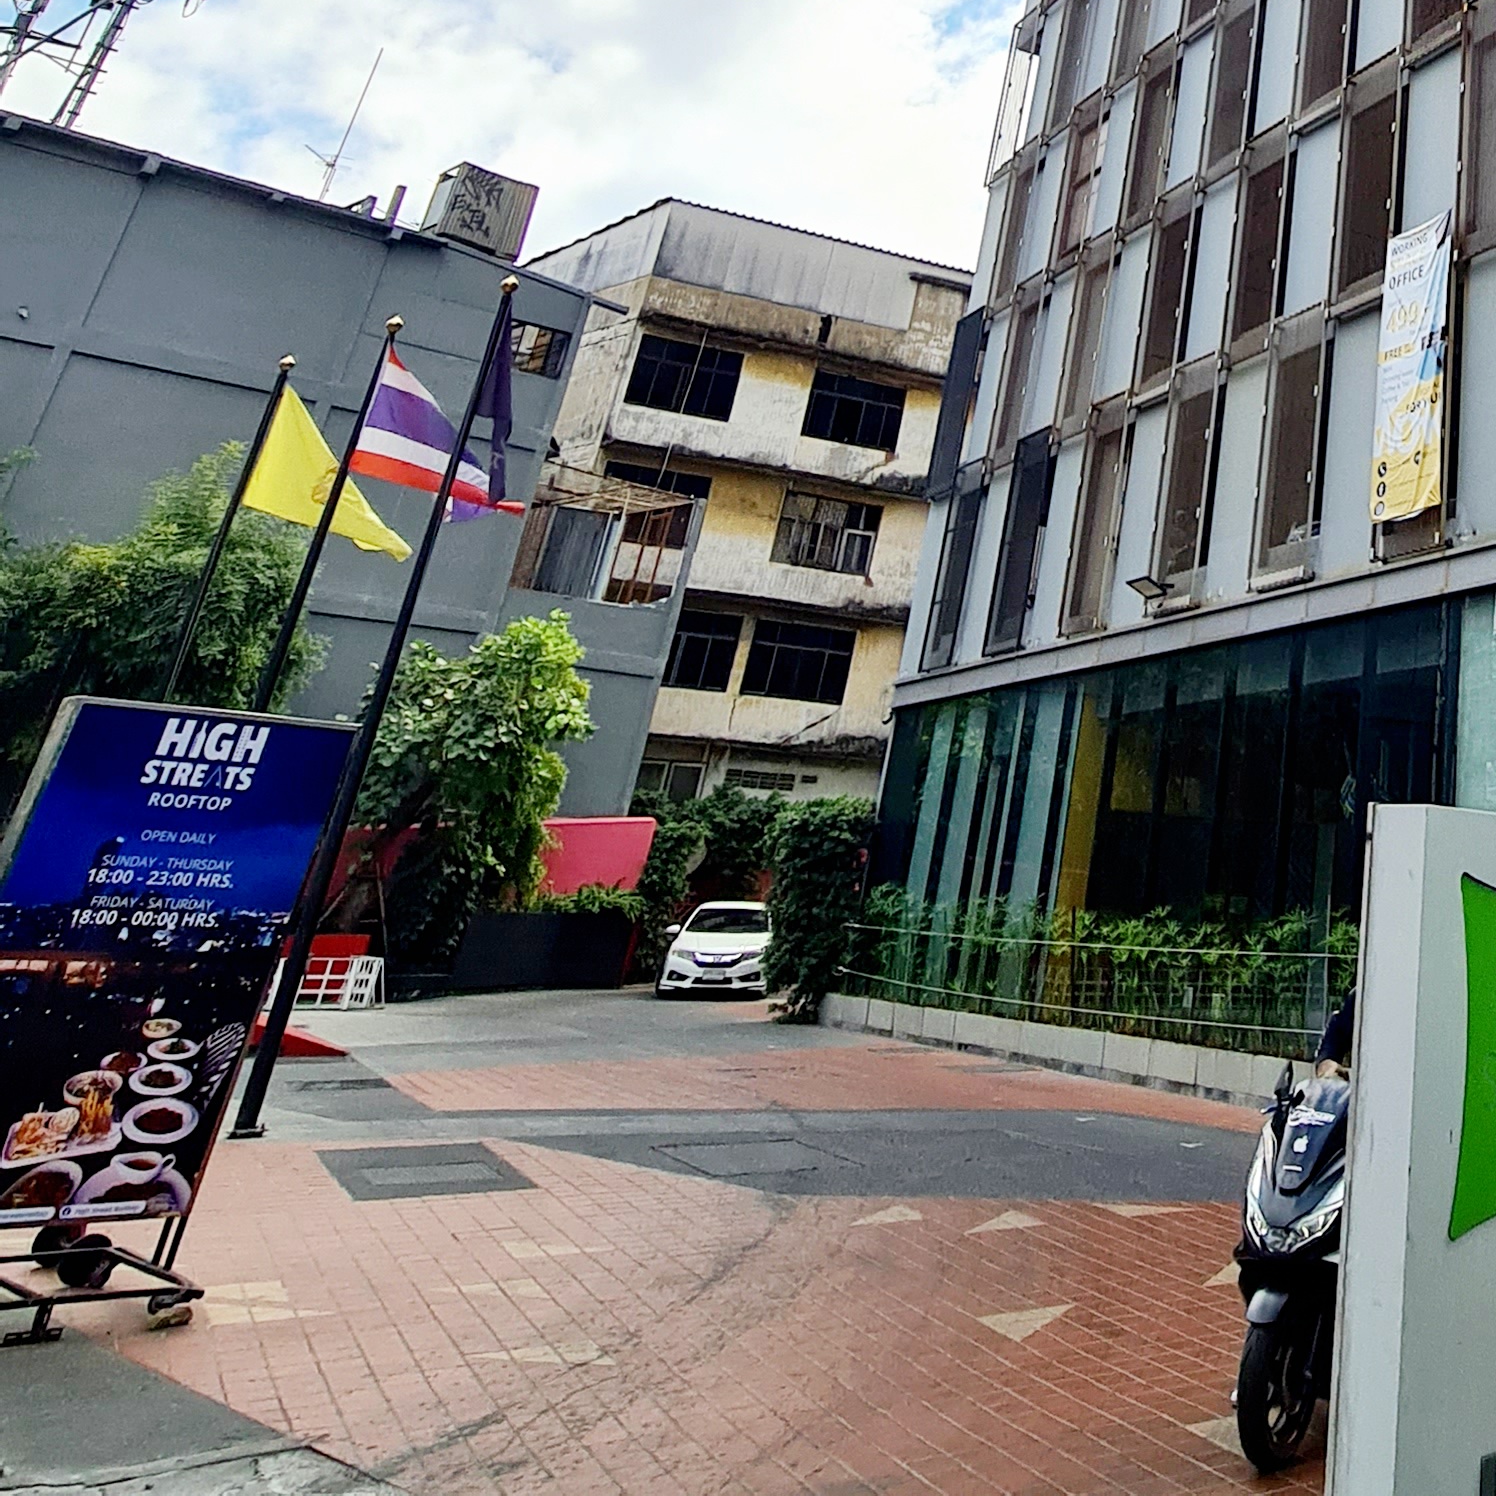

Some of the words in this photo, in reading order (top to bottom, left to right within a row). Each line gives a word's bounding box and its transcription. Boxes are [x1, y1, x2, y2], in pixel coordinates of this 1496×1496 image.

[1388, 264, 1424, 290] OFFICE
[155, 717, 271, 764] HIGH
[147, 791, 232, 811] ROOFTOP
[141, 829, 177, 843] OPEN
[179, 831, 216, 845] DAILY
[101, 854, 157, 868] SUNDAY
[167, 857, 234, 871] THURSDAY
[88, 868, 134, 884] 18:00
[145, 870, 193, 886] 23:00
[195, 873, 234, 888] HRS.
[89, 895, 139, 909] FRIDAY
[146, 897, 215, 911] SATURDAY
[71, 909, 118, 925] 18:00
[131, 911, 179, 927] 00:00
[181, 912, 219, 928] HRS.
